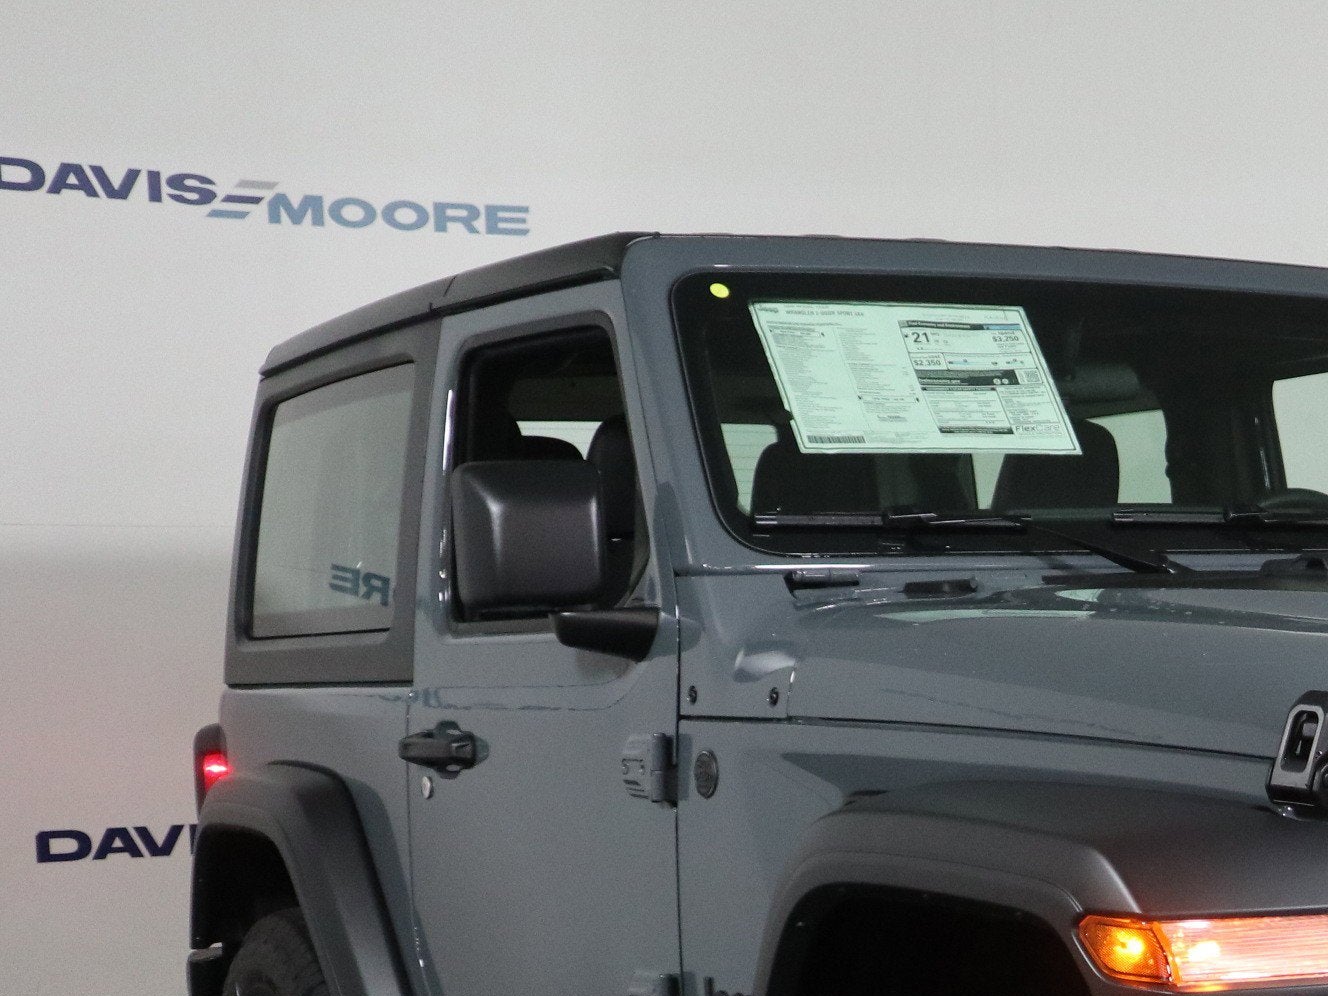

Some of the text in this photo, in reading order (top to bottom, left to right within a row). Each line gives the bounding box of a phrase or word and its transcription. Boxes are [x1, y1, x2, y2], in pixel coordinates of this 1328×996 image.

[0, 155, 531, 236] DAVIS MOORE
[911, 331, 931, 344] 21
